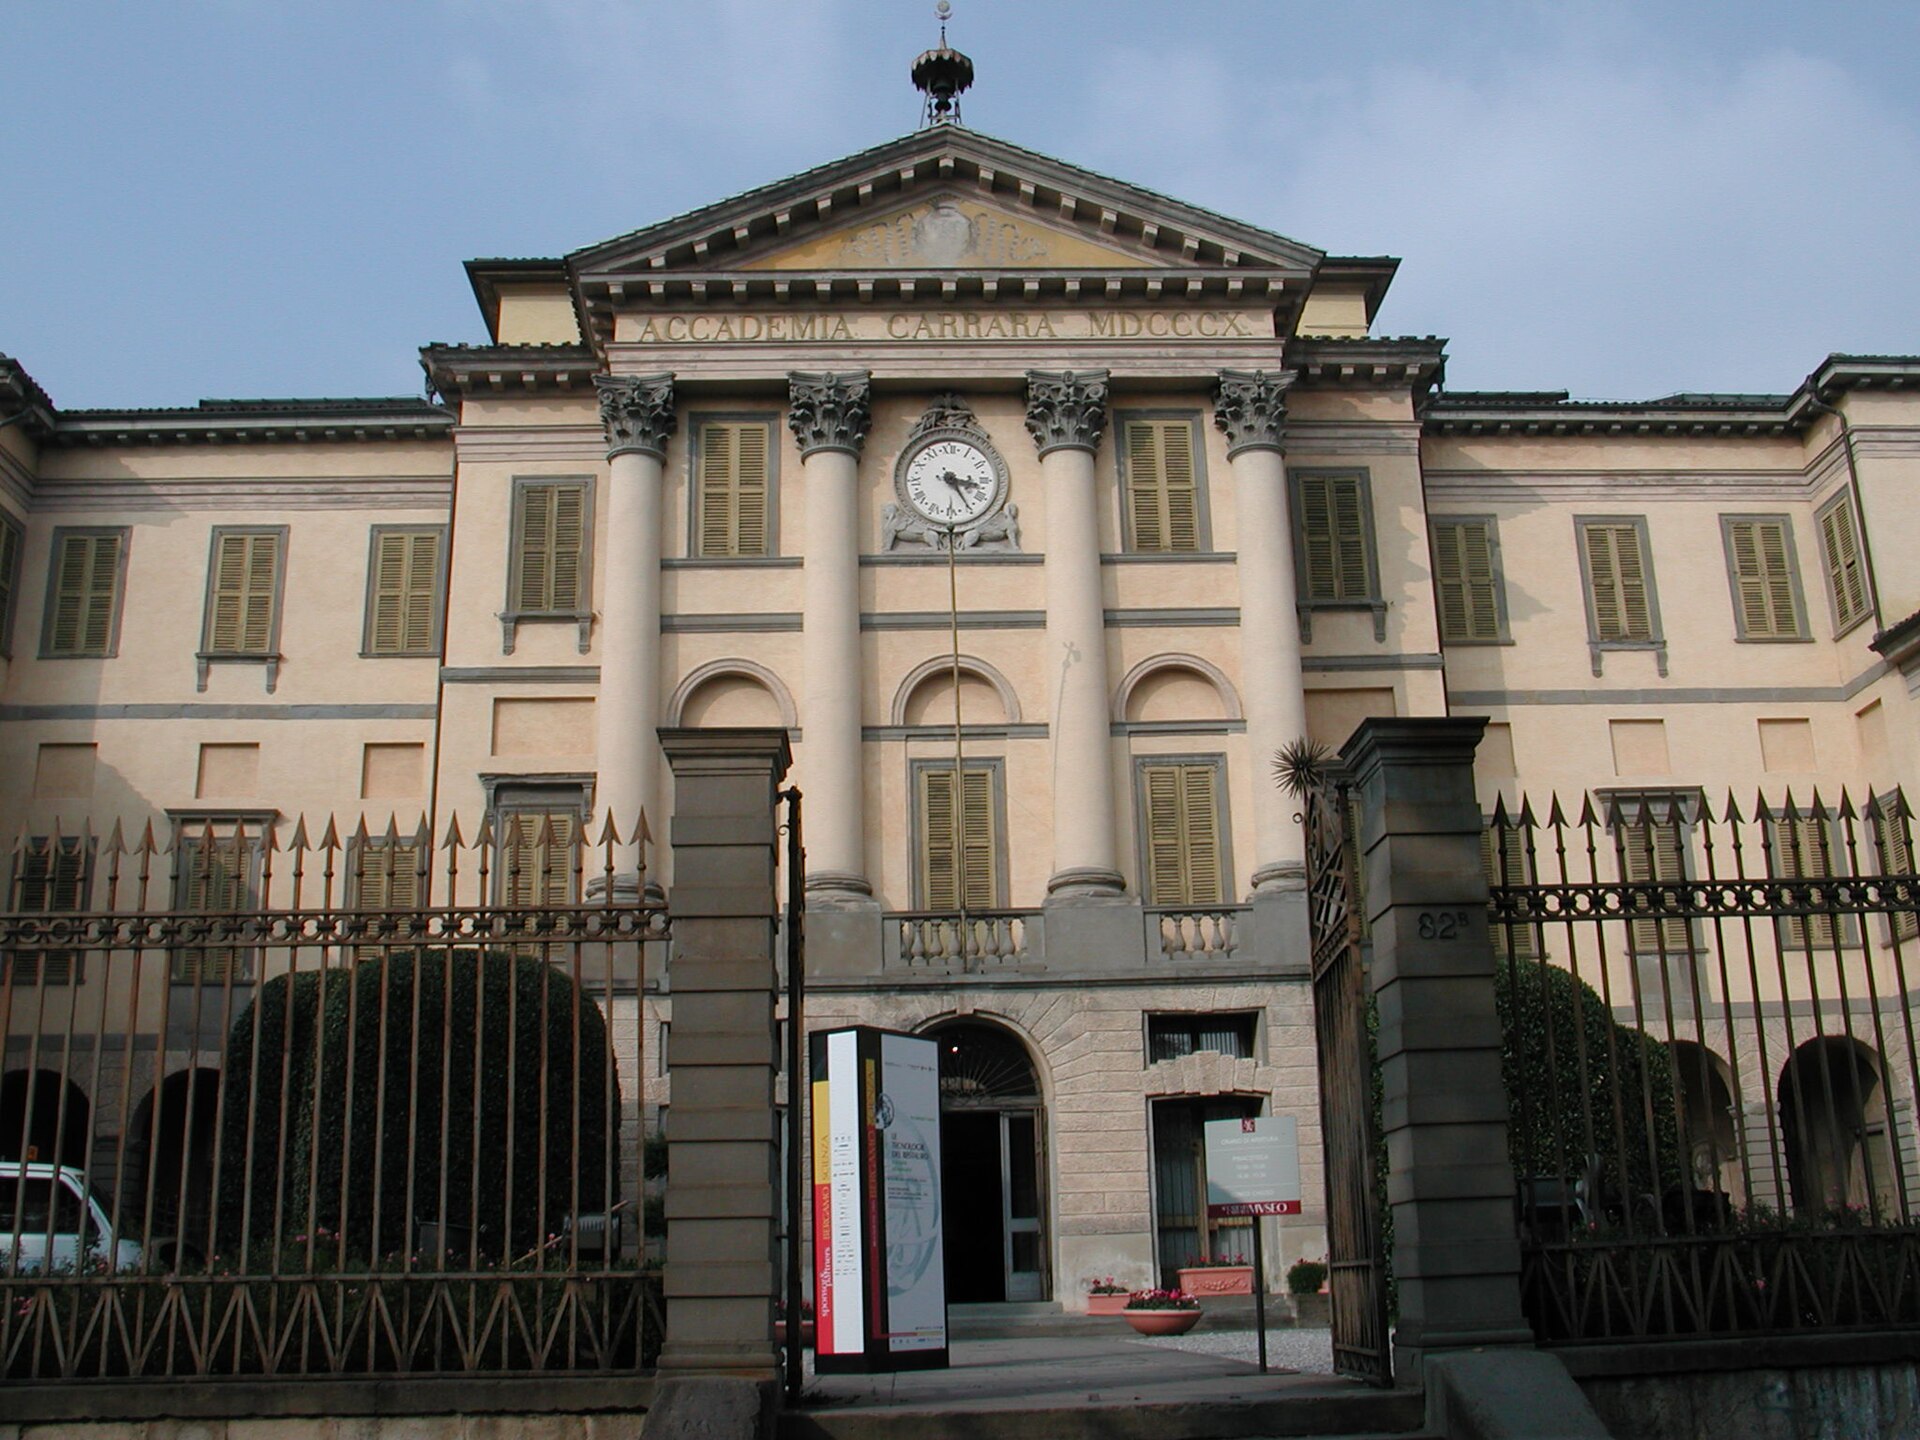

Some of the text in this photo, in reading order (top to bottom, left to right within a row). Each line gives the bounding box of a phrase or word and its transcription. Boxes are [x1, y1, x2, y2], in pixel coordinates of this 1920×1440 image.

[638, 313, 853, 342] ACCADEMIA
[886, 312, 1058, 339] CARRARA
[820, 1135, 830, 1240] BERGAMO SCIENZA
[824, 1247, 833, 1287] partners
